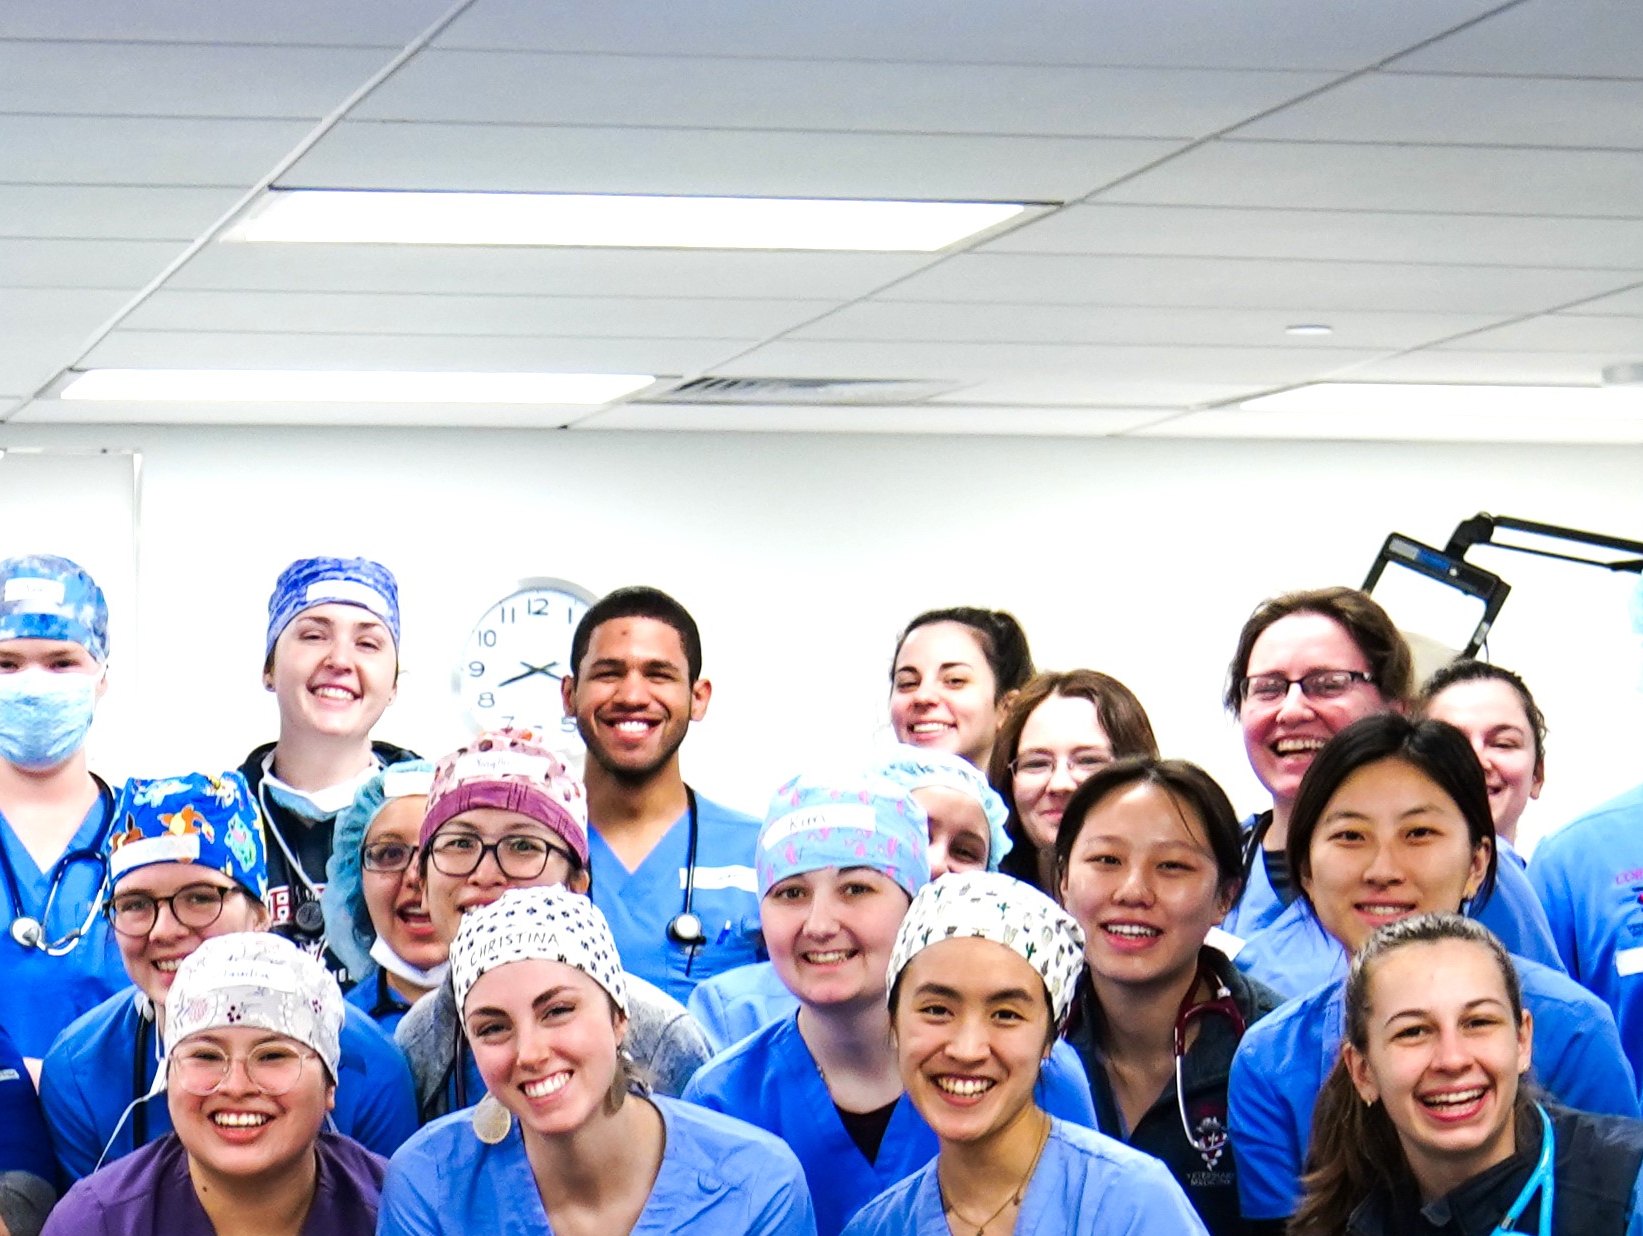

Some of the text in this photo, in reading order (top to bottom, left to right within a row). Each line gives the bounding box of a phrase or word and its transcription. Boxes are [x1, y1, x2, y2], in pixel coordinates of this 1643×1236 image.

[501, 607, 515, 624] 11
[527, 598, 549, 616] 12
[568, 607, 572, 624] 1
[478, 630, 497, 647] 10
[468, 661, 485, 677] 9
[478, 692, 495, 708] 8
[470, 931, 560, 967] CHRISTINA
